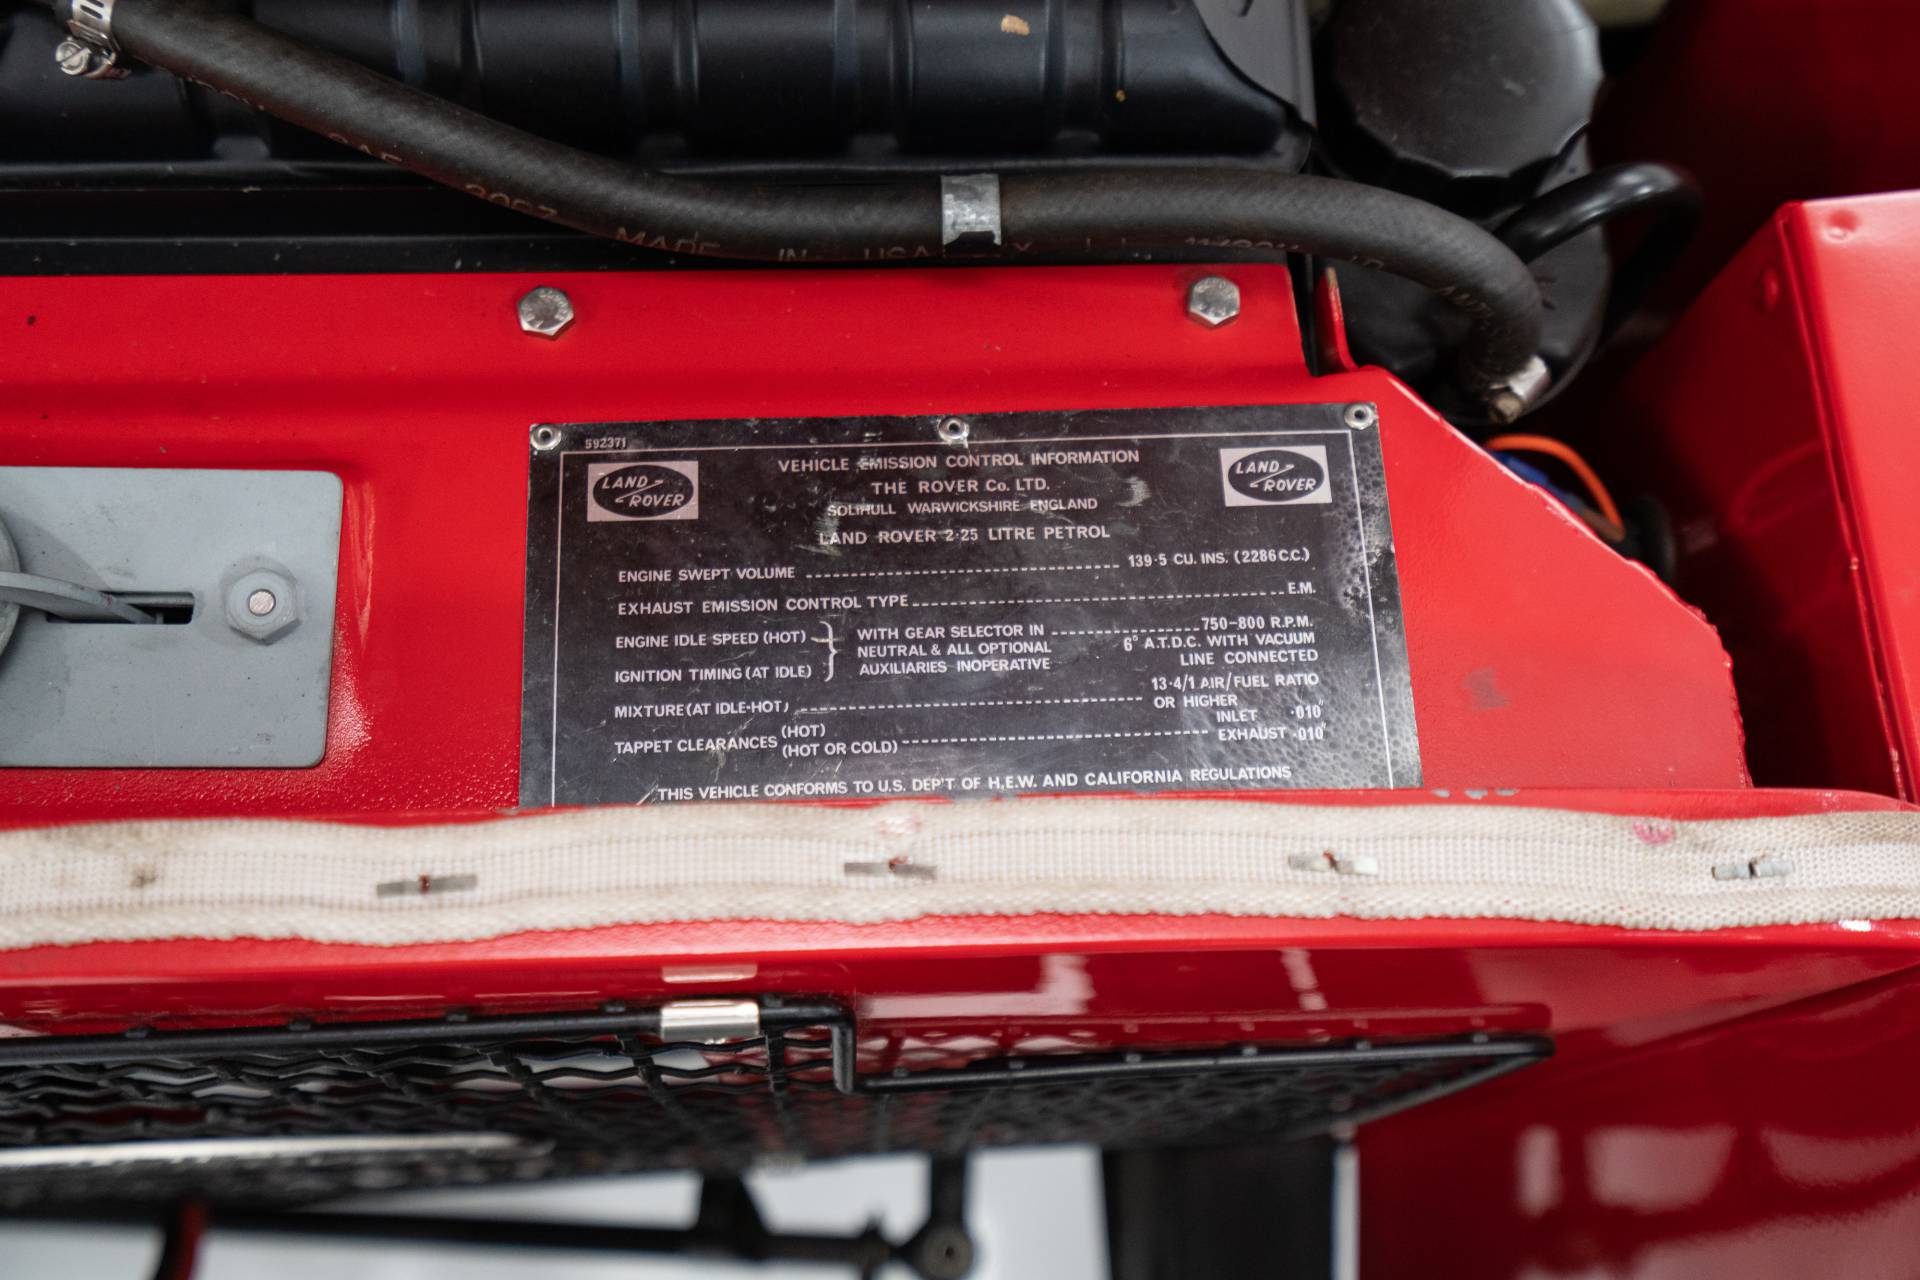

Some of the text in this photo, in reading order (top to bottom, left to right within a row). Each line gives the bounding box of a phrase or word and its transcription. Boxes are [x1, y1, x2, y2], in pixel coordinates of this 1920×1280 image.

[585, 437, 626, 449] 592371
[778, 450, 1140, 473] VEHICLE EMISSION CONTROL INFORMATION
[1235, 461, 1280, 475] LAND
[601, 475, 648, 490] LAND
[871, 477, 1050, 495] THE ROVER Co. LTD.
[1263, 478, 1317, 492] ROVER
[629, 493, 685, 508] ROVER
[827, 497, 1098, 517] SOLIHULL WARWICKSHIRE ENGLAND
[819, 531, 867, 546] LAND
[878, 529, 937, 544] ROVER
[988, 527, 1036, 541] LITRE
[1044, 525, 1111, 540] PETROL
[618, 570, 672, 583] ENGINE
[678, 568, 730, 581] SWEPT
[736, 566, 796, 580] VOLUME
[1173, 552, 1197, 565] CU.
[1201, 552, 1229, 564] INS.
[618, 581, 1317, 616] EXHAUST EMISSION CONTROL TYPE E.M.
[1271, 615, 1314, 629] R.P.M.
[615, 630, 807, 648] ENGINE IDLE SPEED (HOT)
[857, 624, 1045, 641] WITH GEAR SELECTOR IN
[1144, 635, 1202, 649] A.T.D.C.
[1207, 634, 1249, 647] WITH
[1256, 632, 1315, 645] VACUUM
[857, 641, 1052, 658] NEUTRAL & ALL OPTIONAL
[1180, 649, 1319, 666] LINE CONNECTED
[615, 668, 682, 683] IGNITION
[775, 664, 812, 680] IDLE)
[859, 658, 1051, 676] AUXILIARIES INOPERATIVE
[1200, 672, 1269, 691] AIR/FUEL
[1275, 673, 1319, 686] RATIO
[715, 700, 789, 715] IDLE-HOT)
[1154, 694, 1238, 709] OR HIGHER
[1216, 709, 1258, 723] INLET
[781, 723, 826, 738] (HOT)
[1218, 726, 1287, 741] EXHAUST
[615, 736, 778, 754] TAPPET CLEARANCES
[782, 740, 898, 758] (HOT OR COLD)
[658, 765, 1292, 801] THIS VEHICLE CONFORMS TO U.S. DEP'T OF H.E.W. AND CALIFORNIA REGULATIONS
